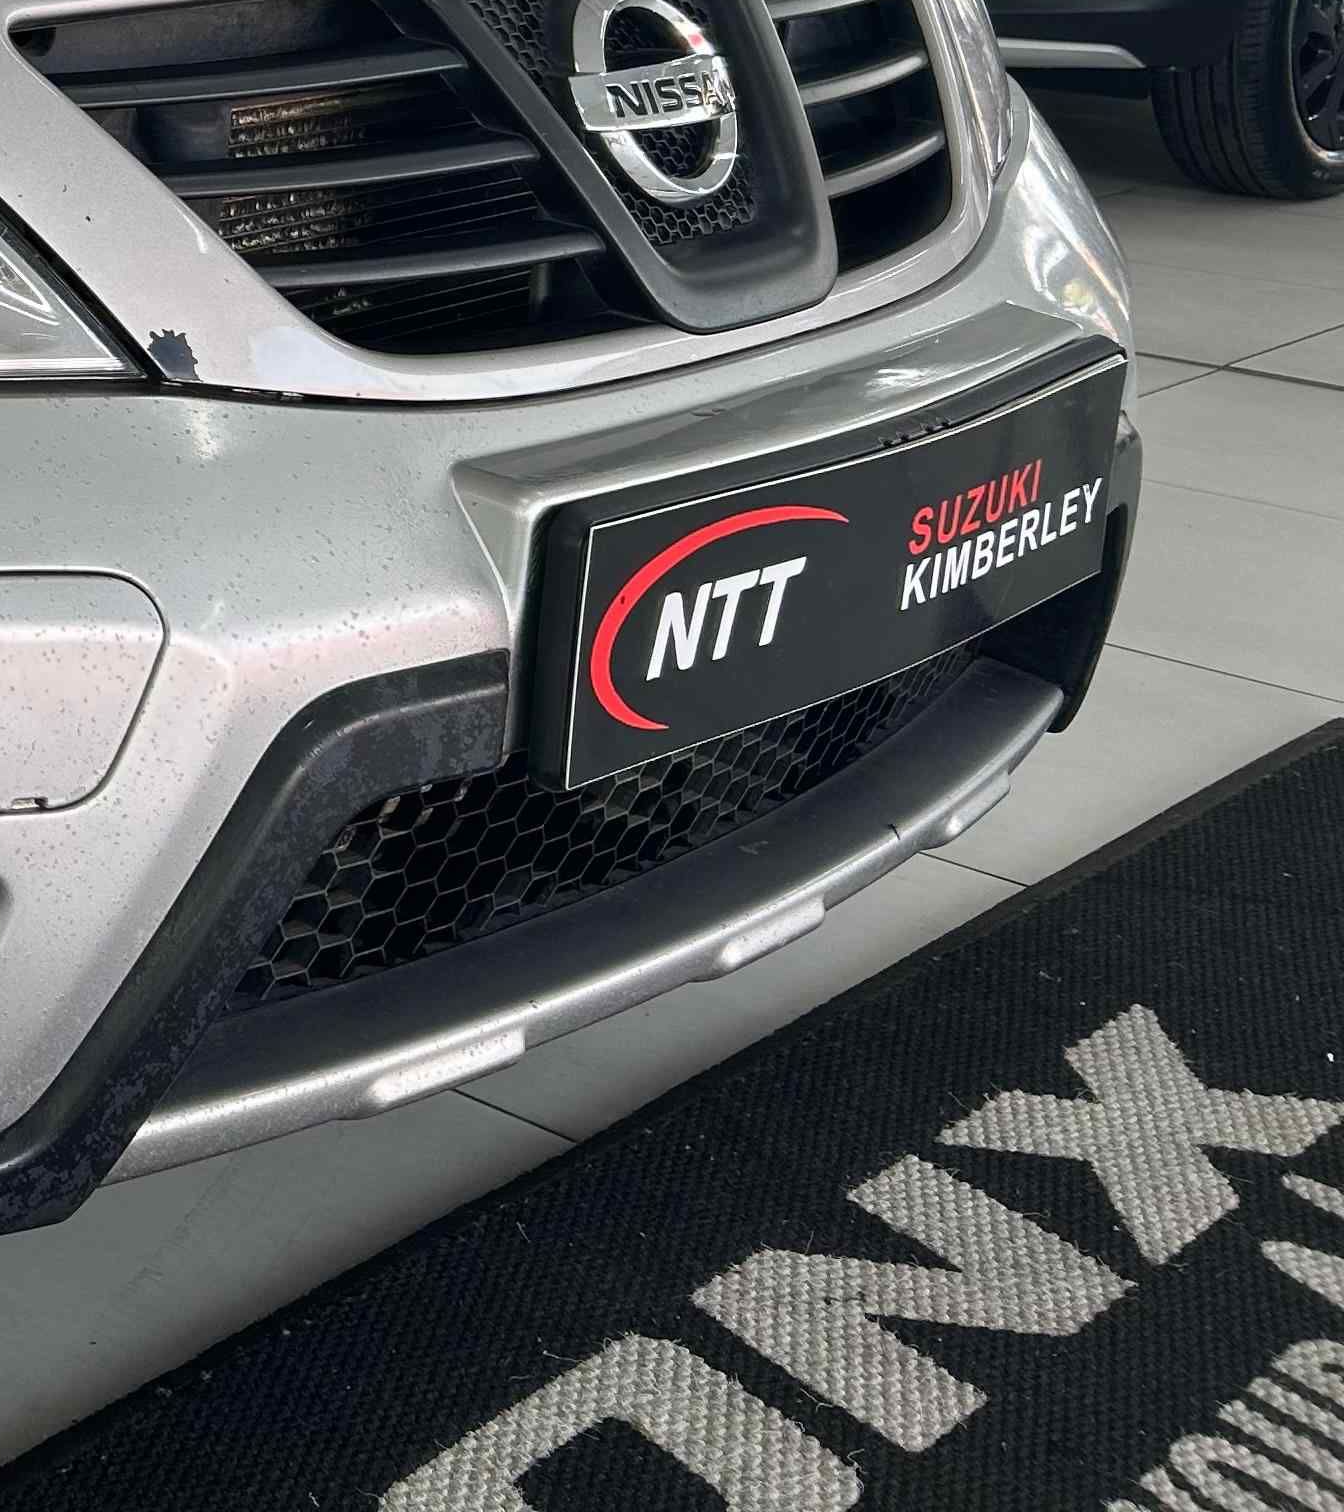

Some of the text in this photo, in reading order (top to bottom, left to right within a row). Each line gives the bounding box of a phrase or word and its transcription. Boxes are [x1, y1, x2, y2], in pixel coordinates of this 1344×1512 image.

[900, 477, 1103, 611] KIMBERLEY
[908, 459, 1042, 556] SUZUKI
[646, 556, 807, 681] NTT
